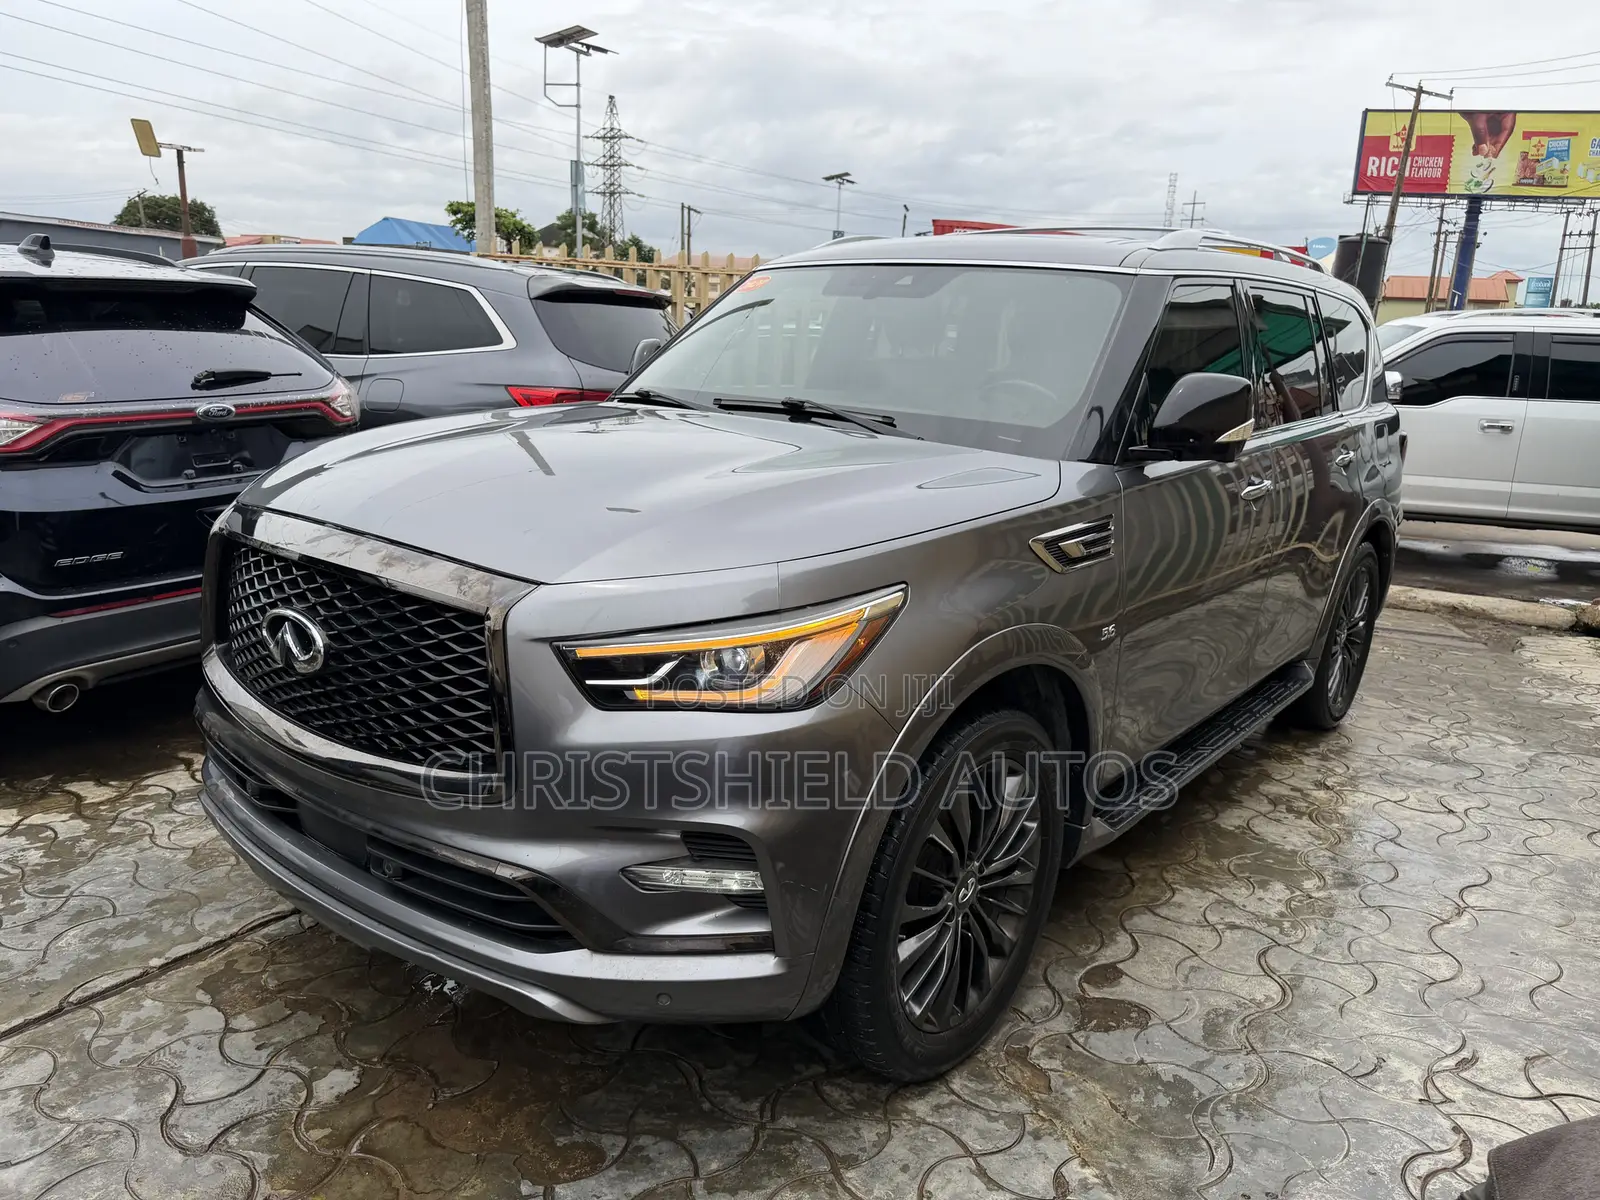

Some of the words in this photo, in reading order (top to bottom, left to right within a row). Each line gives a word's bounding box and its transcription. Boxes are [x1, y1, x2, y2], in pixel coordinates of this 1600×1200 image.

[1412, 156, 1444, 167] CHICKEN
[1410, 168, 1442, 178] FLAVOUR
[209, 407, 228, 417] Ford
[54, 551, 124, 567] EDGE
